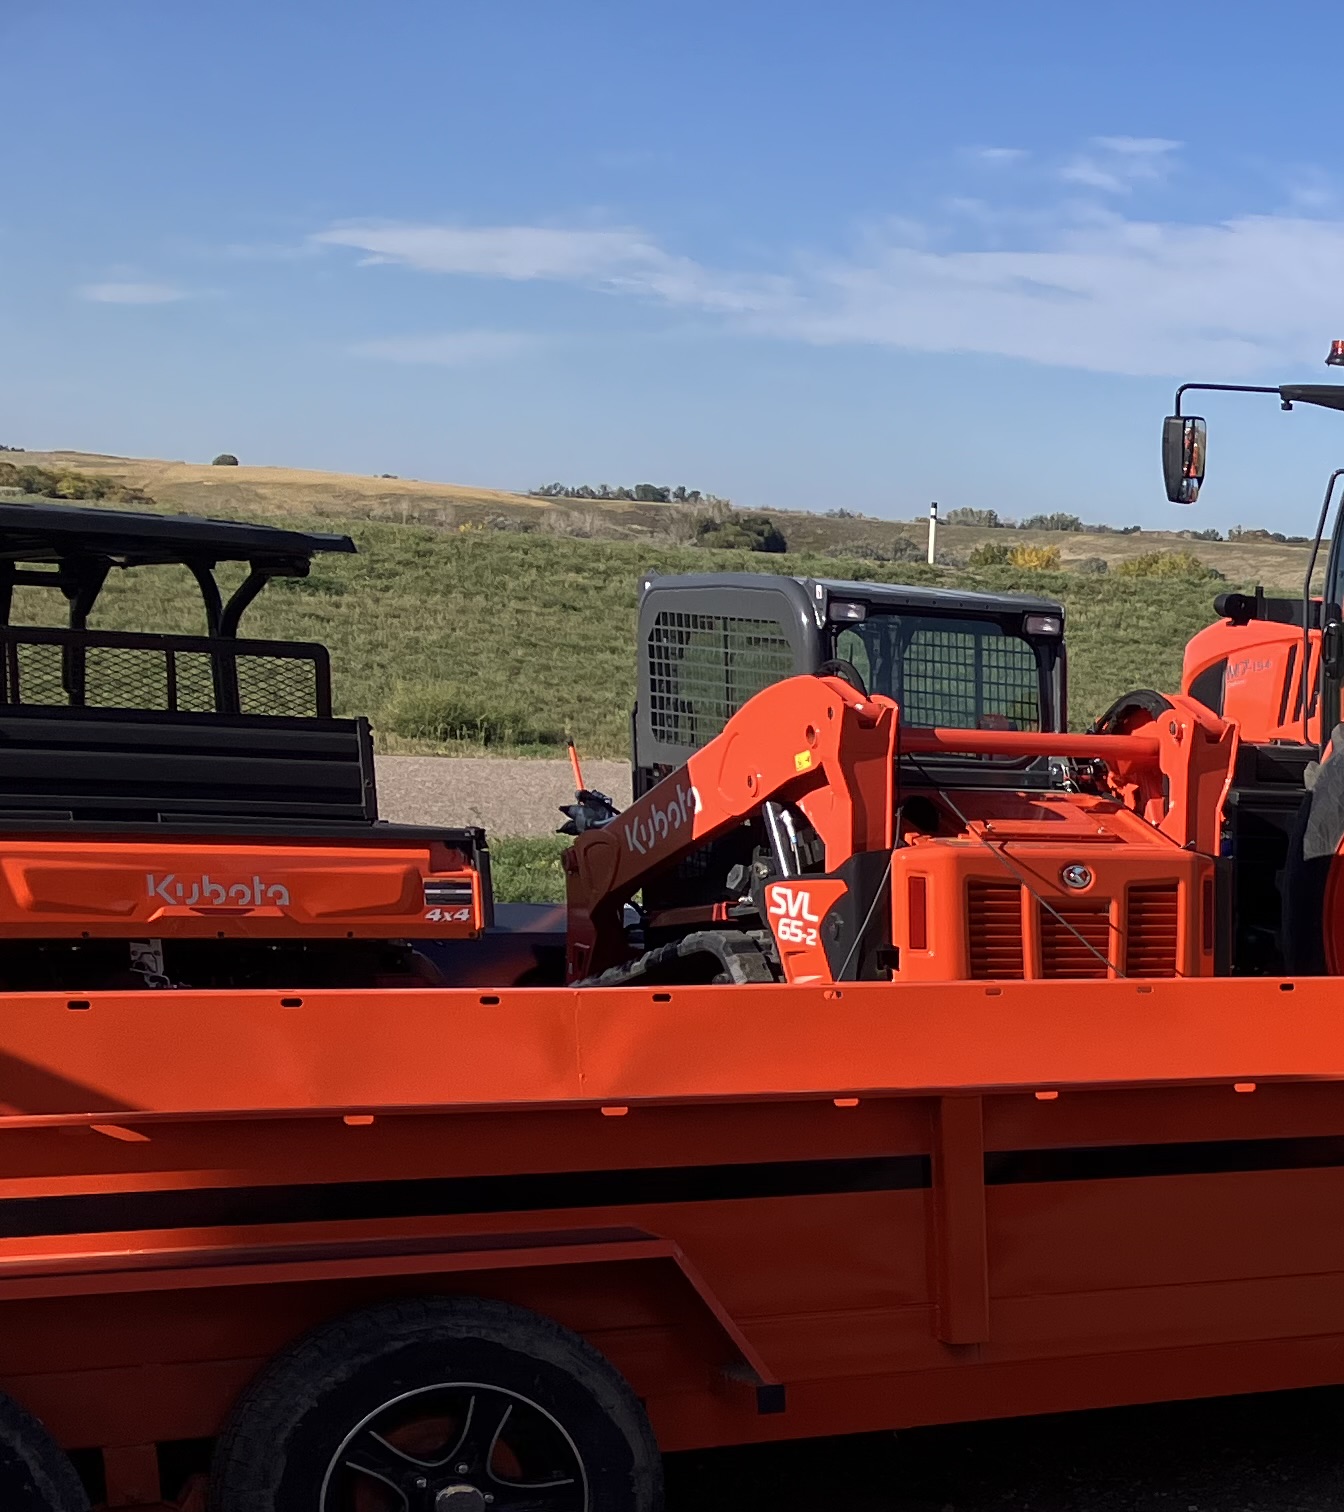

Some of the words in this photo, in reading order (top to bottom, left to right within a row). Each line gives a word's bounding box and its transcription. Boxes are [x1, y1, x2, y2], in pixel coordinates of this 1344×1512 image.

[624, 784, 702, 854] Kubota
[147, 873, 290, 906] Kubota
[769, 885, 819, 923] SVL
[424, 908, 471, 922] 4x4
[777, 917, 818, 946] 65-2
